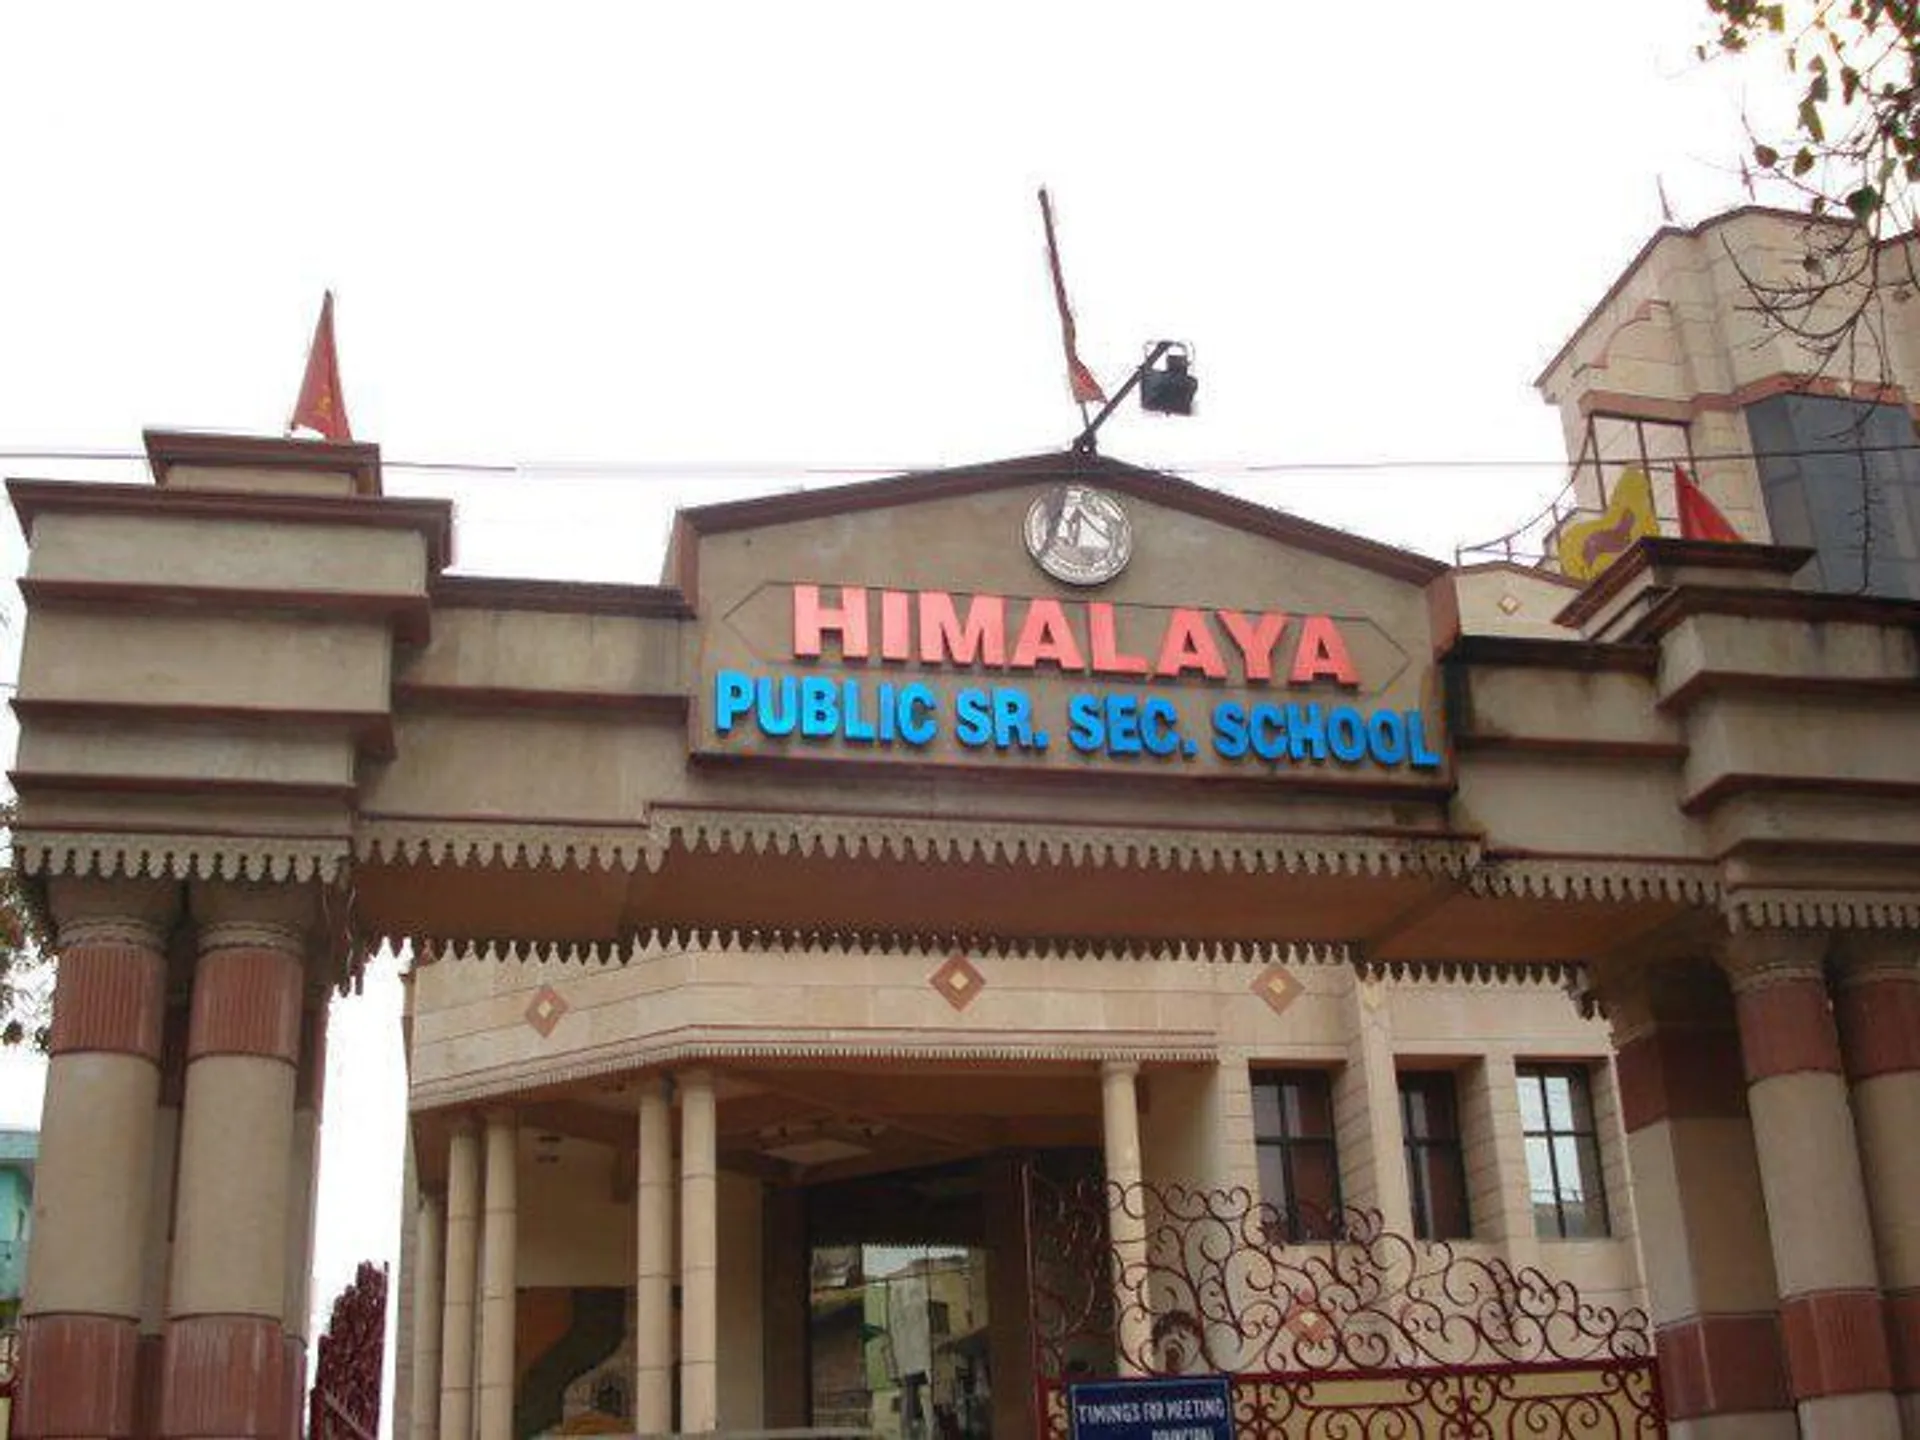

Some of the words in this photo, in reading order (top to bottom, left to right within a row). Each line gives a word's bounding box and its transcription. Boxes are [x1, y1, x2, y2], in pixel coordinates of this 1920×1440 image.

[793, 584, 1361, 688] HIMALAYA
[715, 669, 938, 745] PUBLIC
[955, 686, 1049, 750] SR.
[1067, 693, 1196, 758] SEC.
[1212, 703, 1441, 769] SCHOOL
[1077, 1403, 1140, 1424] TIMINGS
[1143, 1402, 1164, 1421] FOR
[1166, 1398, 1226, 1420] MEETING
